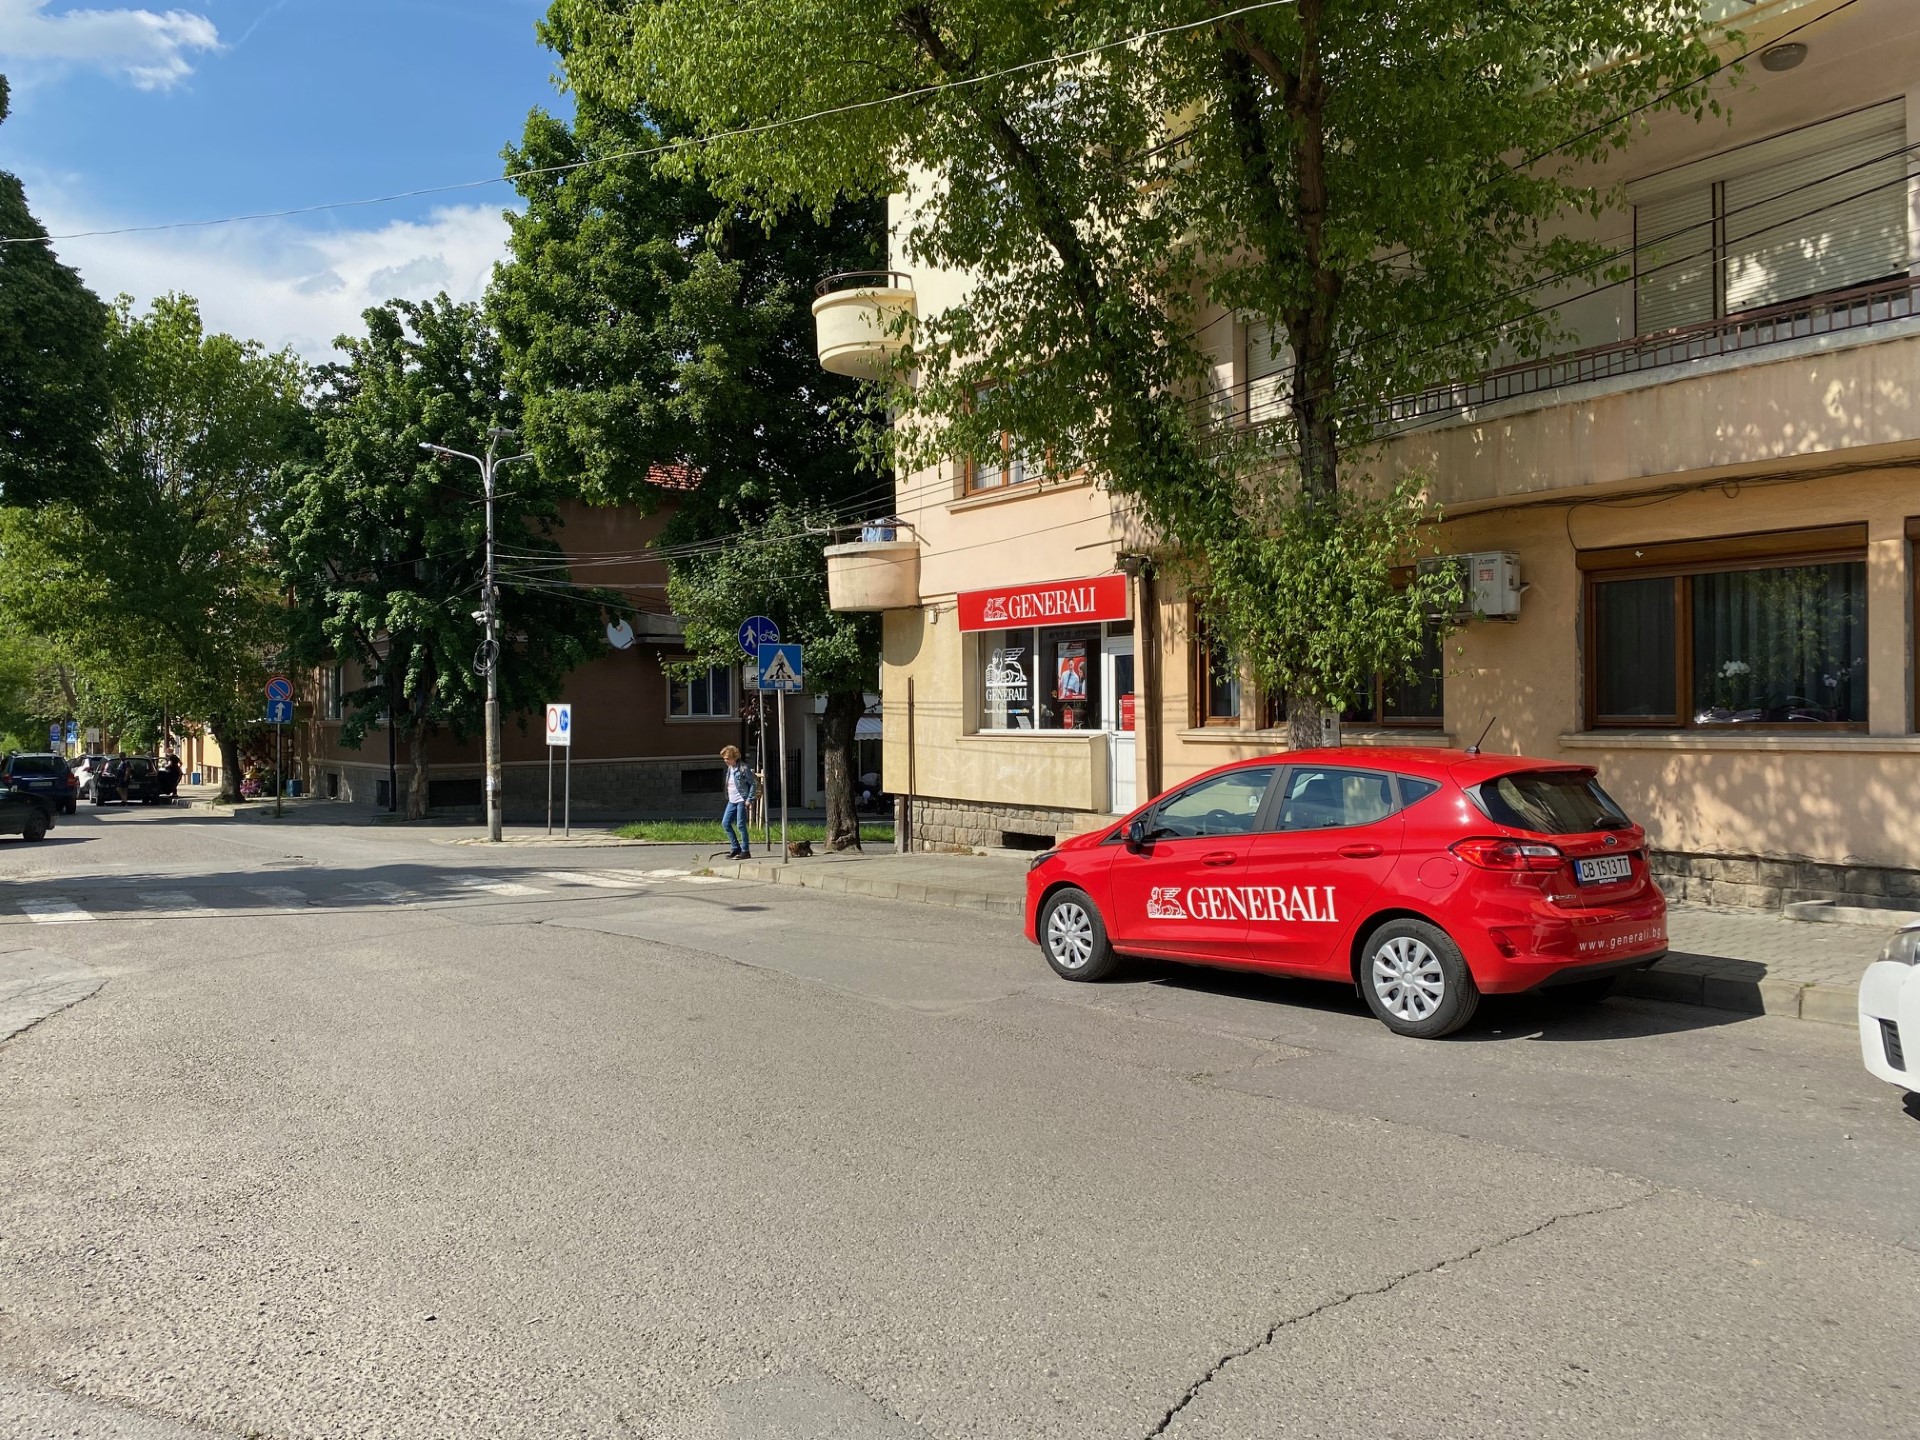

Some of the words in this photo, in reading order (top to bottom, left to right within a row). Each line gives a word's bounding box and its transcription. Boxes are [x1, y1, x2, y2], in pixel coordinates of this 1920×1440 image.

[1009, 587, 1096, 619] GENERALI
[986, 688, 1028, 701] GENERALI
[1582, 862, 1595, 878] CB
[1596, 859, 1618, 876] 1513
[1618, 858, 1629, 874] TT
[1187, 886, 1339, 922] GENERALI
[1579, 927, 1661, 951] www.generali.bg
